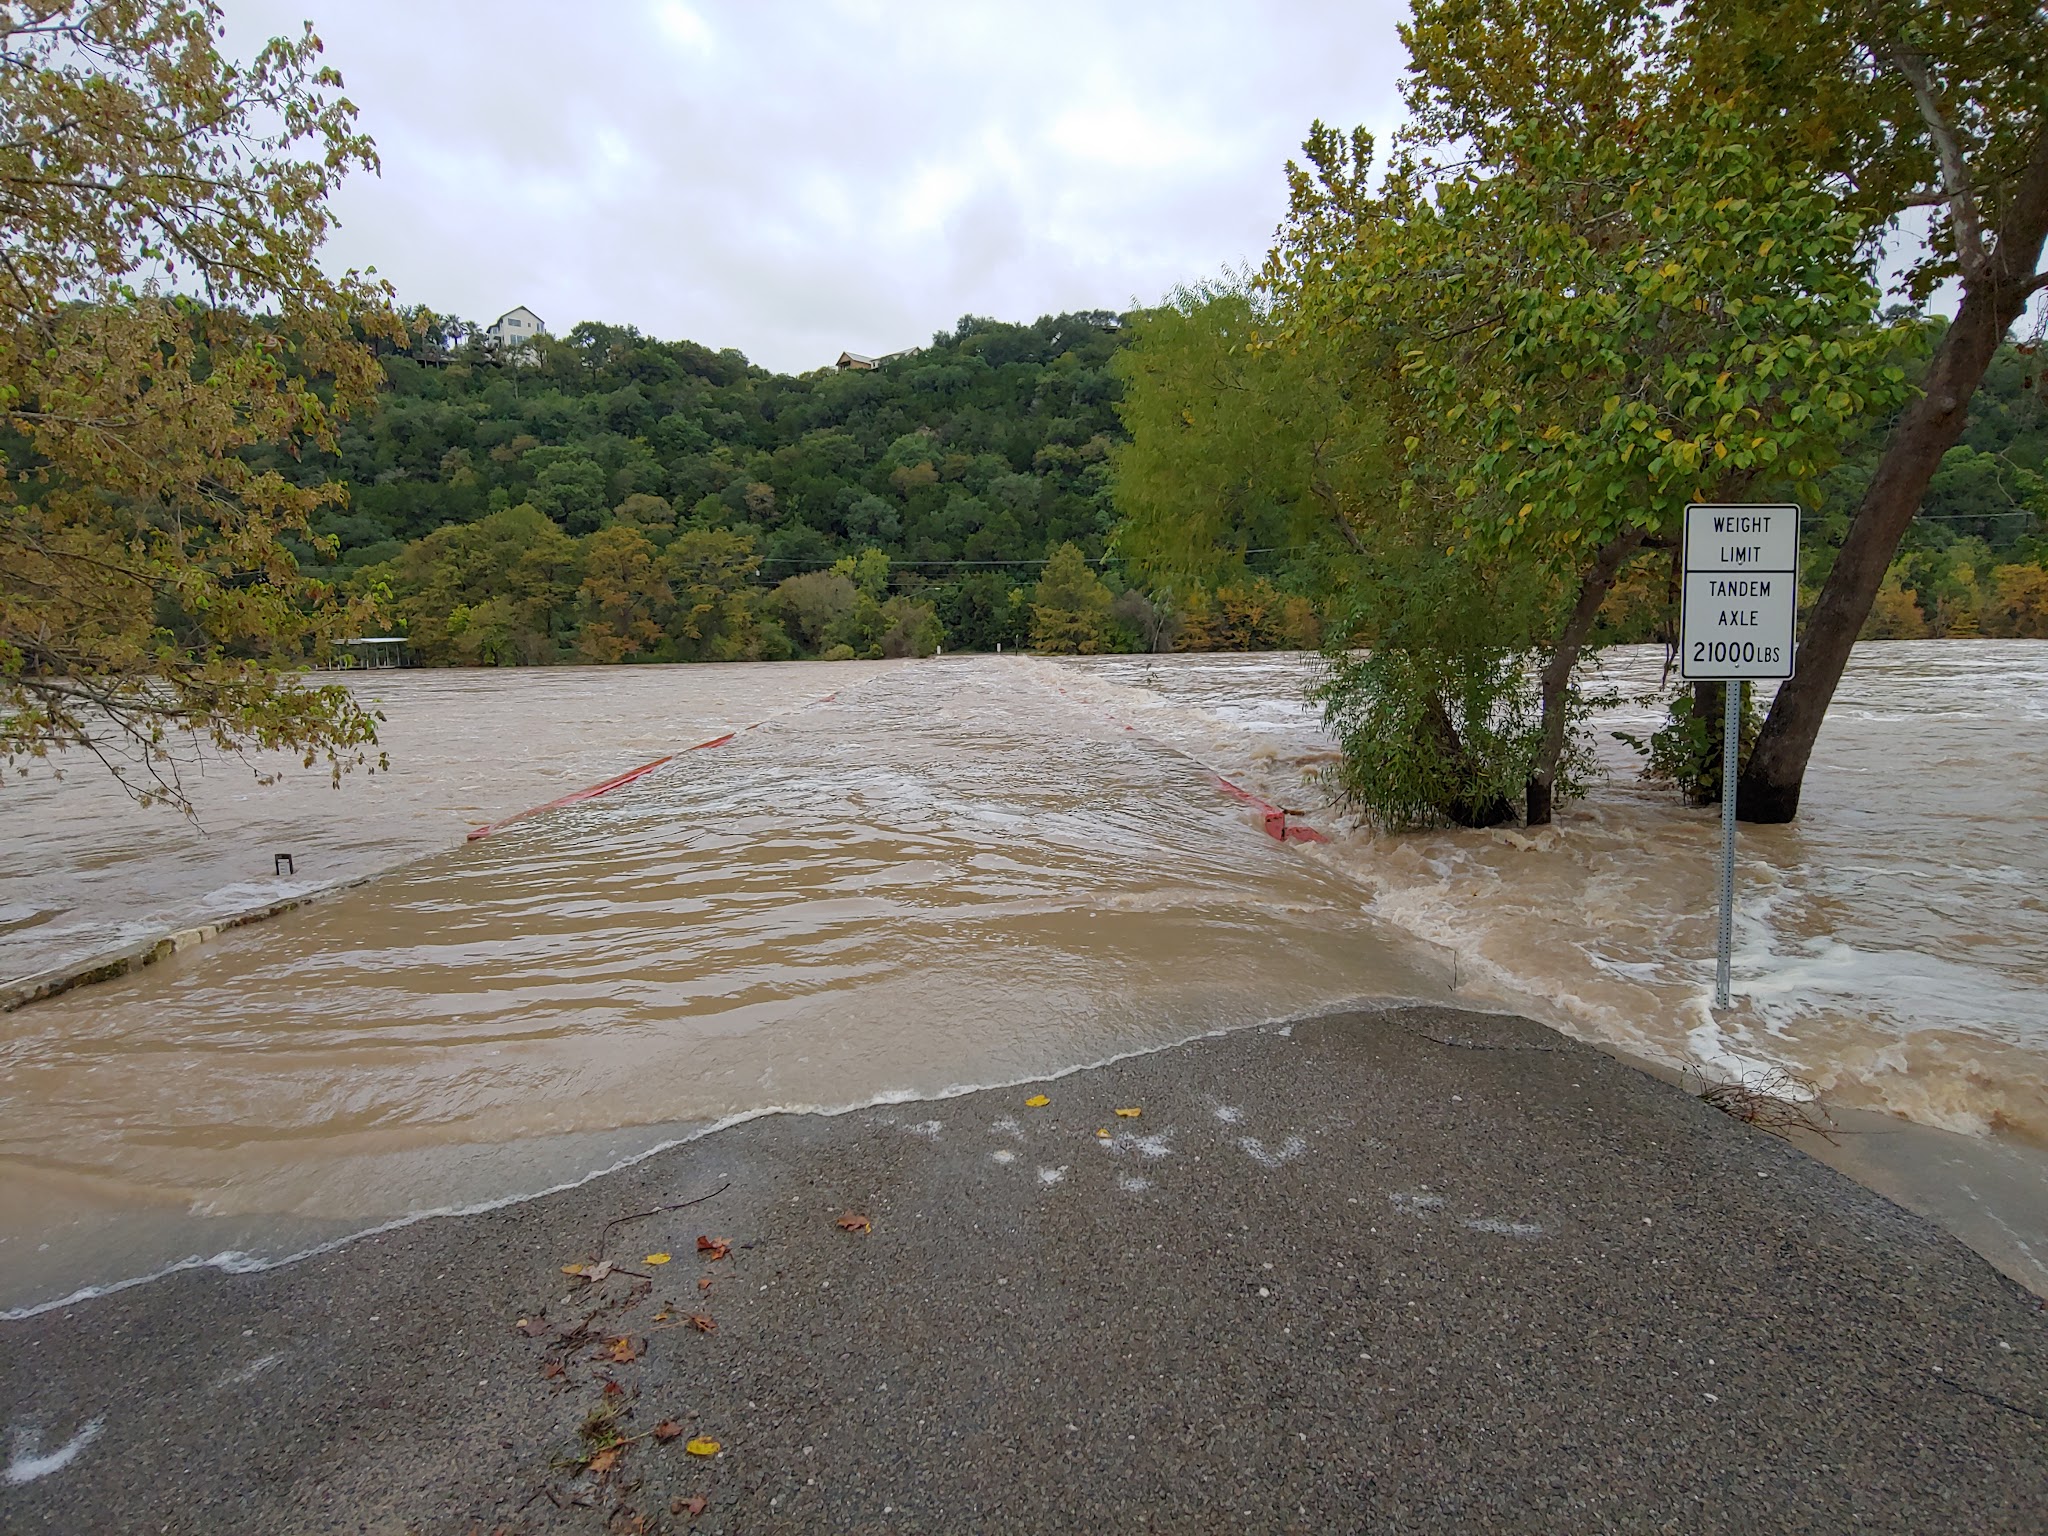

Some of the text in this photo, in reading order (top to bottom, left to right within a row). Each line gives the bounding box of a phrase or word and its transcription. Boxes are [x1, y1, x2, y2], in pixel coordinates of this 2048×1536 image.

[1714, 517, 1771, 532] WEIGHT
[1721, 547, 1761, 562] LIMIT
[1709, 581, 1770, 596] TANDEM
[1718, 611, 1758, 626] AXLE
